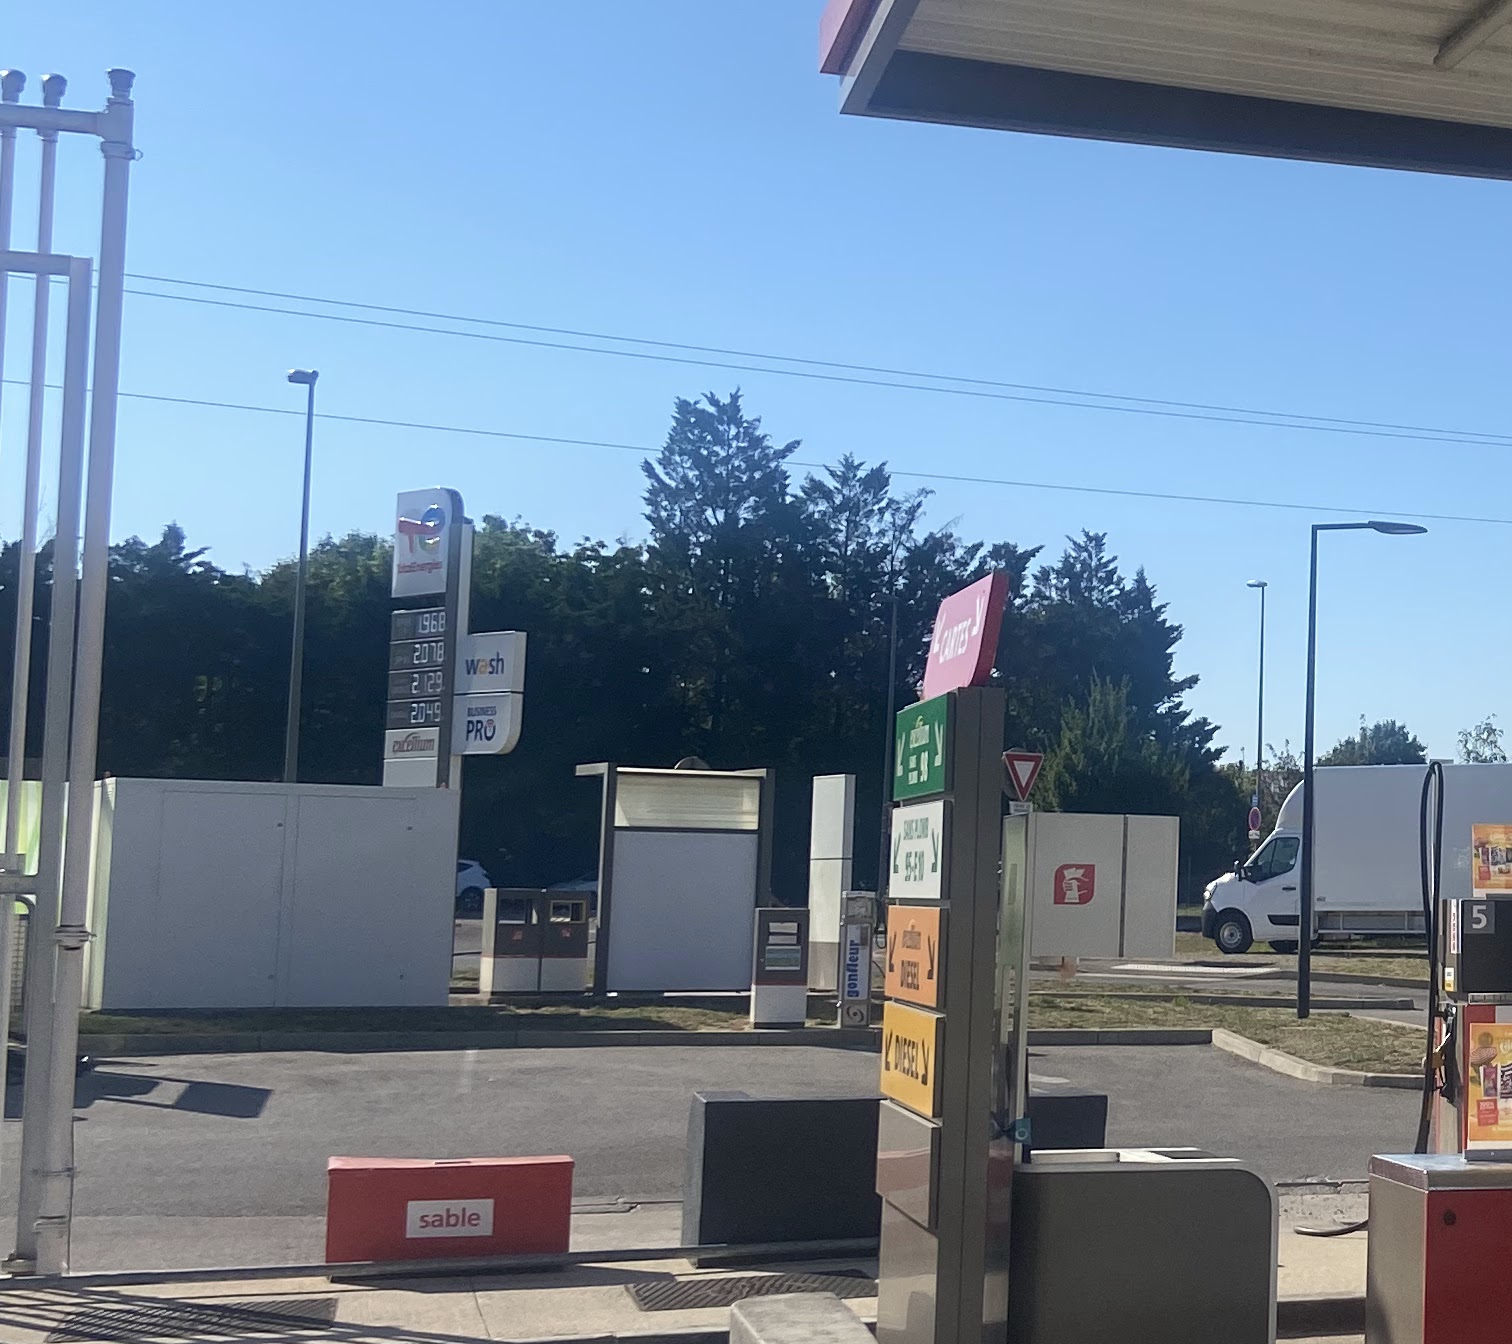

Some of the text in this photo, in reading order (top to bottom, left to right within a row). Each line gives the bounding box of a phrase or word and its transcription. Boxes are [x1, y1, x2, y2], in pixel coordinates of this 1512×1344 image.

[939, 617, 972, 665] CARTES
[465, 651, 505, 675] wash
[465, 719, 497, 742] PRO
[1471, 904, 1488, 930] 5
[846, 939, 860, 998] gonfleur
[894, 1034, 919, 1080] DIESEL
[419, 1207, 481, 1229] sable
